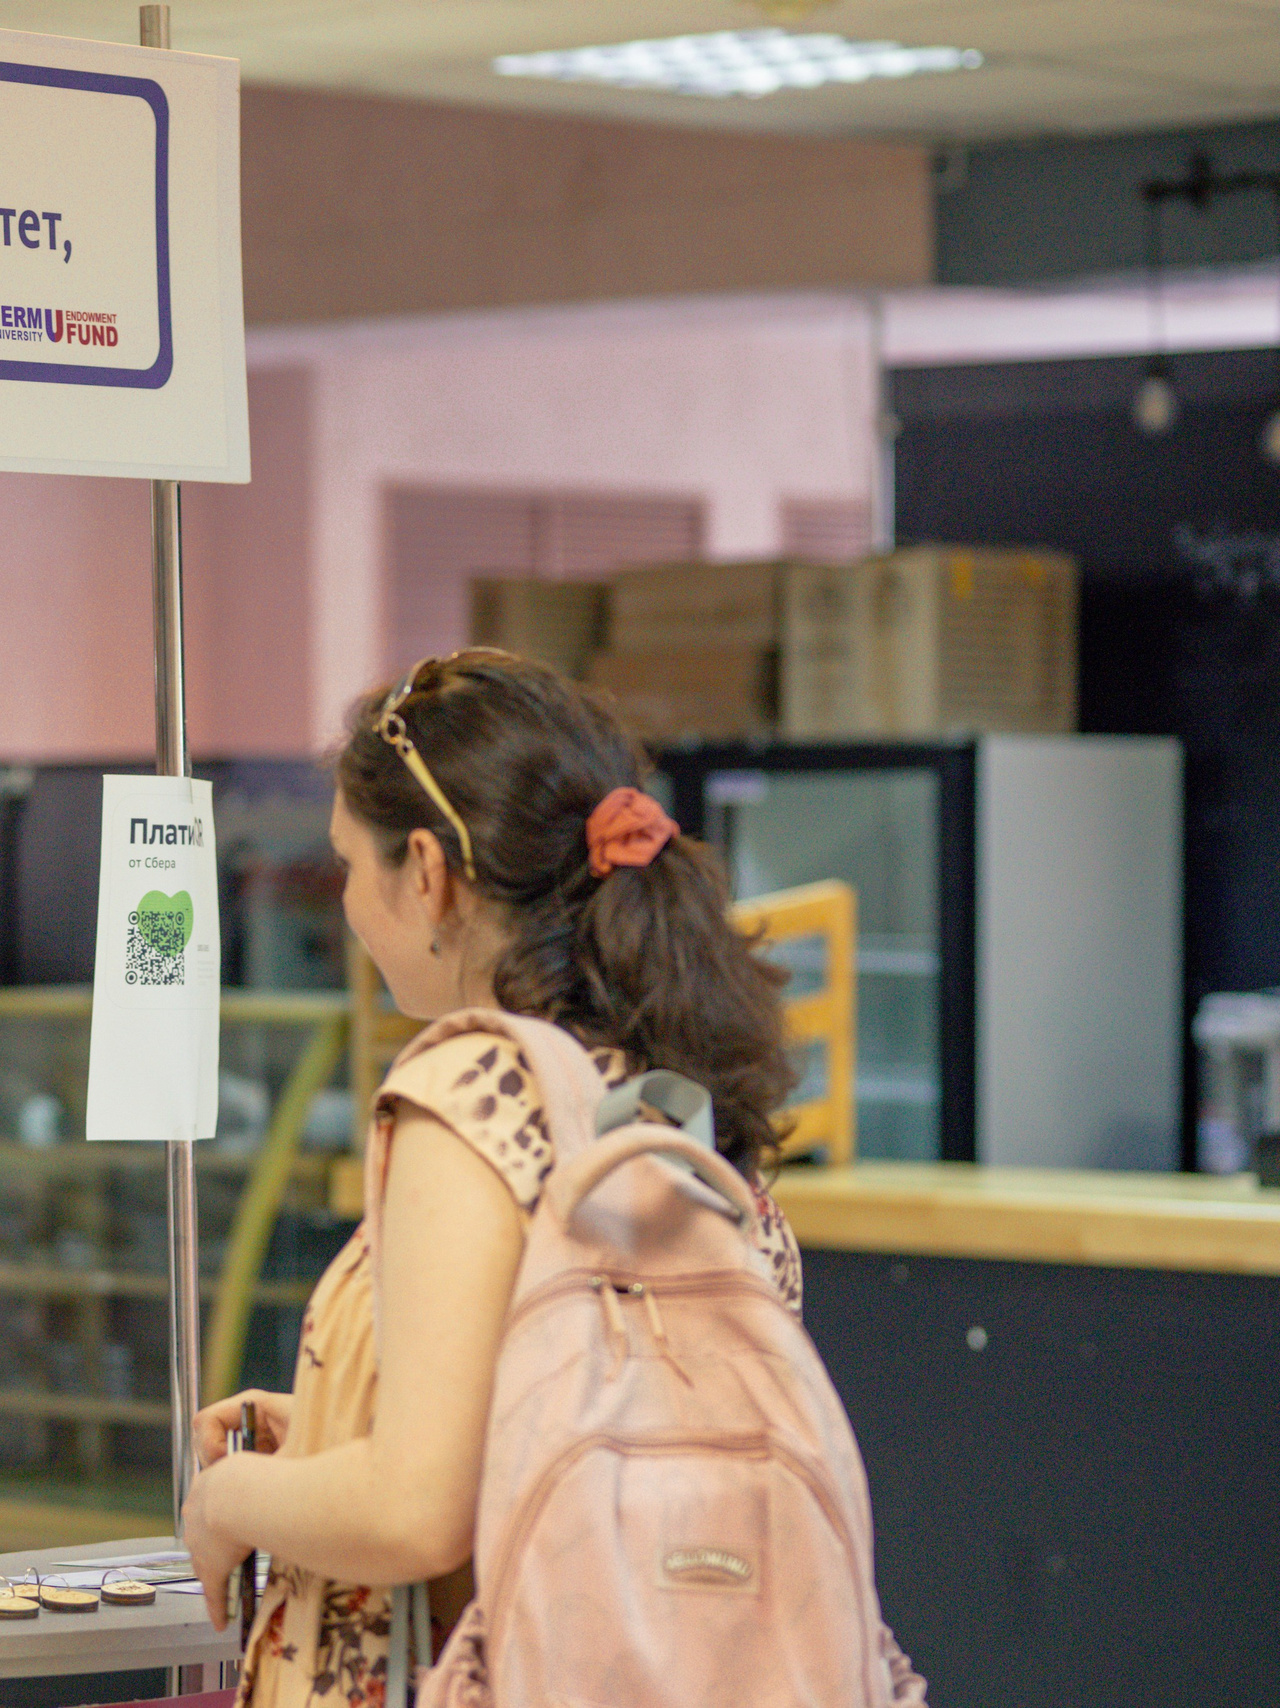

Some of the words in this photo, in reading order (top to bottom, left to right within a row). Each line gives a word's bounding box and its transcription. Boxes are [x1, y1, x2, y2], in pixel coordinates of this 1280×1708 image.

[65, 310, 117, 324] ENDOWMENT
[66, 323, 118, 347] FUND
[128, 859, 141, 868] от
[145, 857, 176, 870] Сбера
